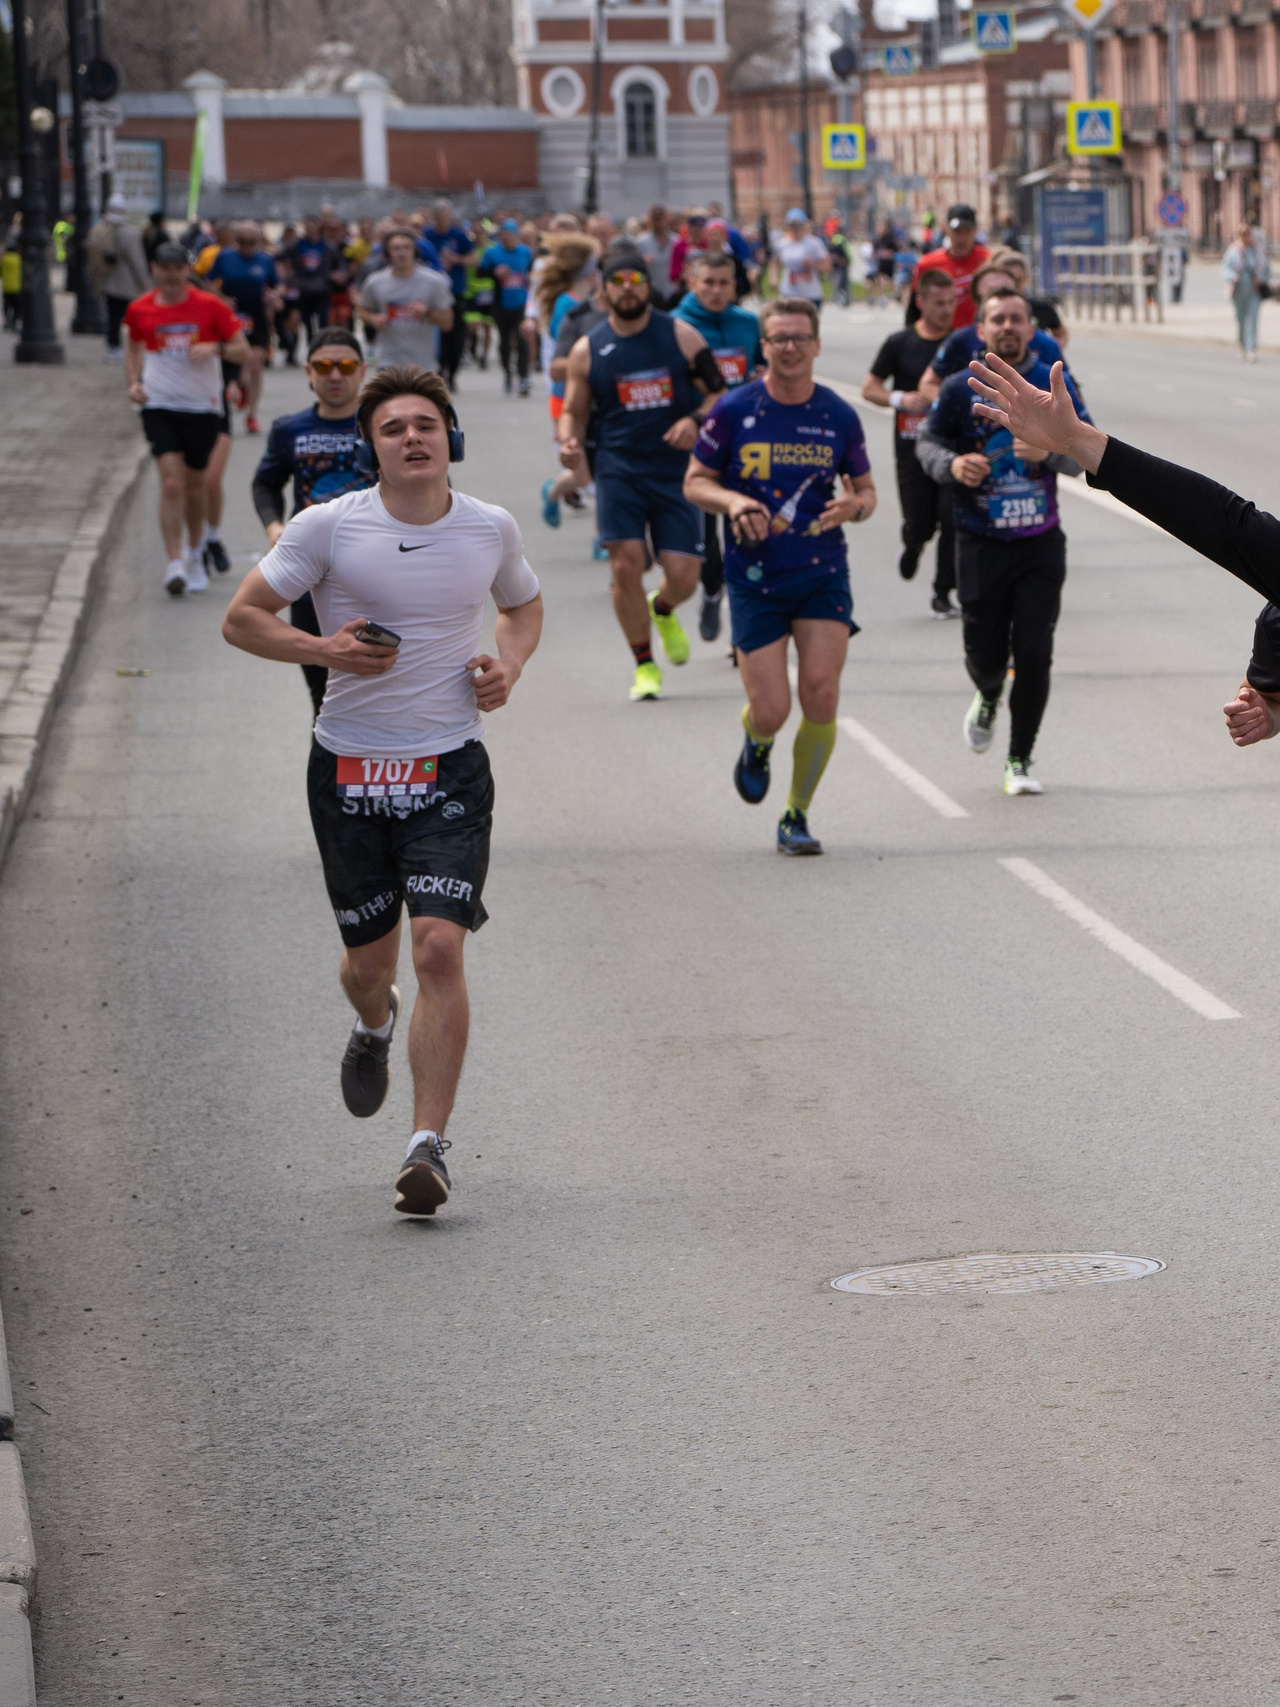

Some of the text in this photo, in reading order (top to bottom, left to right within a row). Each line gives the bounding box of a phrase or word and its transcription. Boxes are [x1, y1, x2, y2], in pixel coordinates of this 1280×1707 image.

[294, 443, 355, 455] КОСМ
[739, 442, 834, 480] Я ПРОСТО
[1001, 497, 1037, 518] 2316
[361, 759, 415, 782] 1707
[424, 763, 433, 771] C
[406, 875, 473, 902] FUCKER
